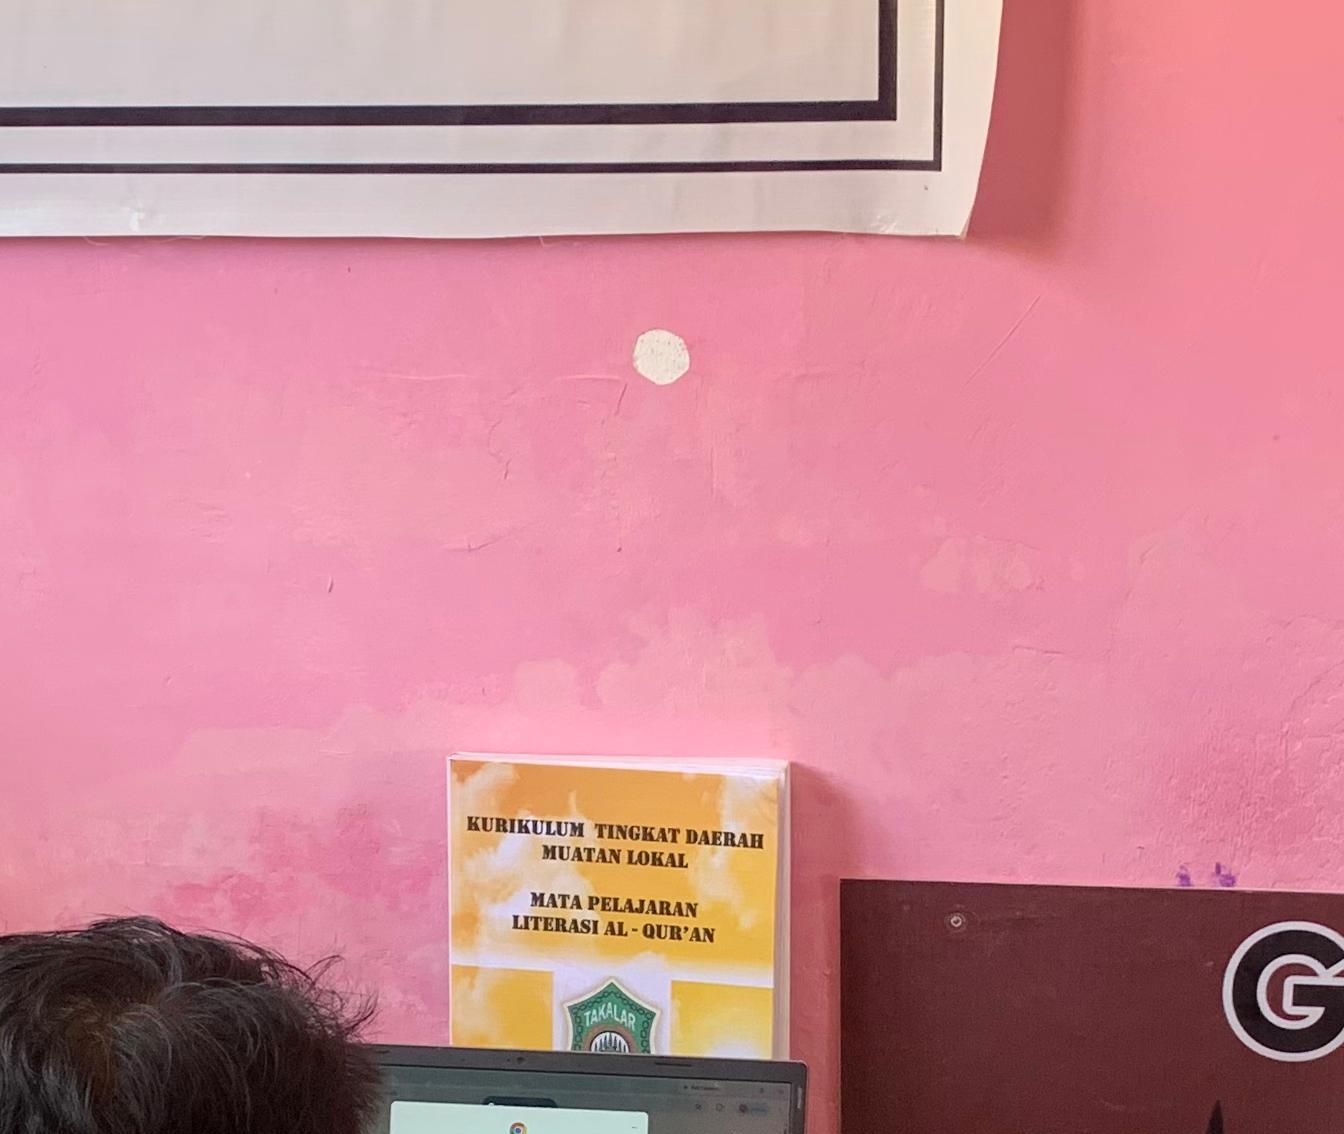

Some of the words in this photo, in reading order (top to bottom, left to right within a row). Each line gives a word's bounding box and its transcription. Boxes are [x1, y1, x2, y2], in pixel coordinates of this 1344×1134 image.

[466, 815, 585, 838] KURIKULUM
[595, 822, 681, 845] TINGKAT
[685, 829, 764, 850] DAERAH
[542, 844, 621, 865] MUATAN
[627, 850, 689, 869] LOKAL
[530, 892, 582, 911] MATA
[588, 896, 699, 919] PELAJARAN
[512, 915, 599, 936] LITERASI
[604, 921, 628, 938] AL
[642, 922, 716, 944] QUR'AN
[583, 1000, 637, 1032] TAKALAR
